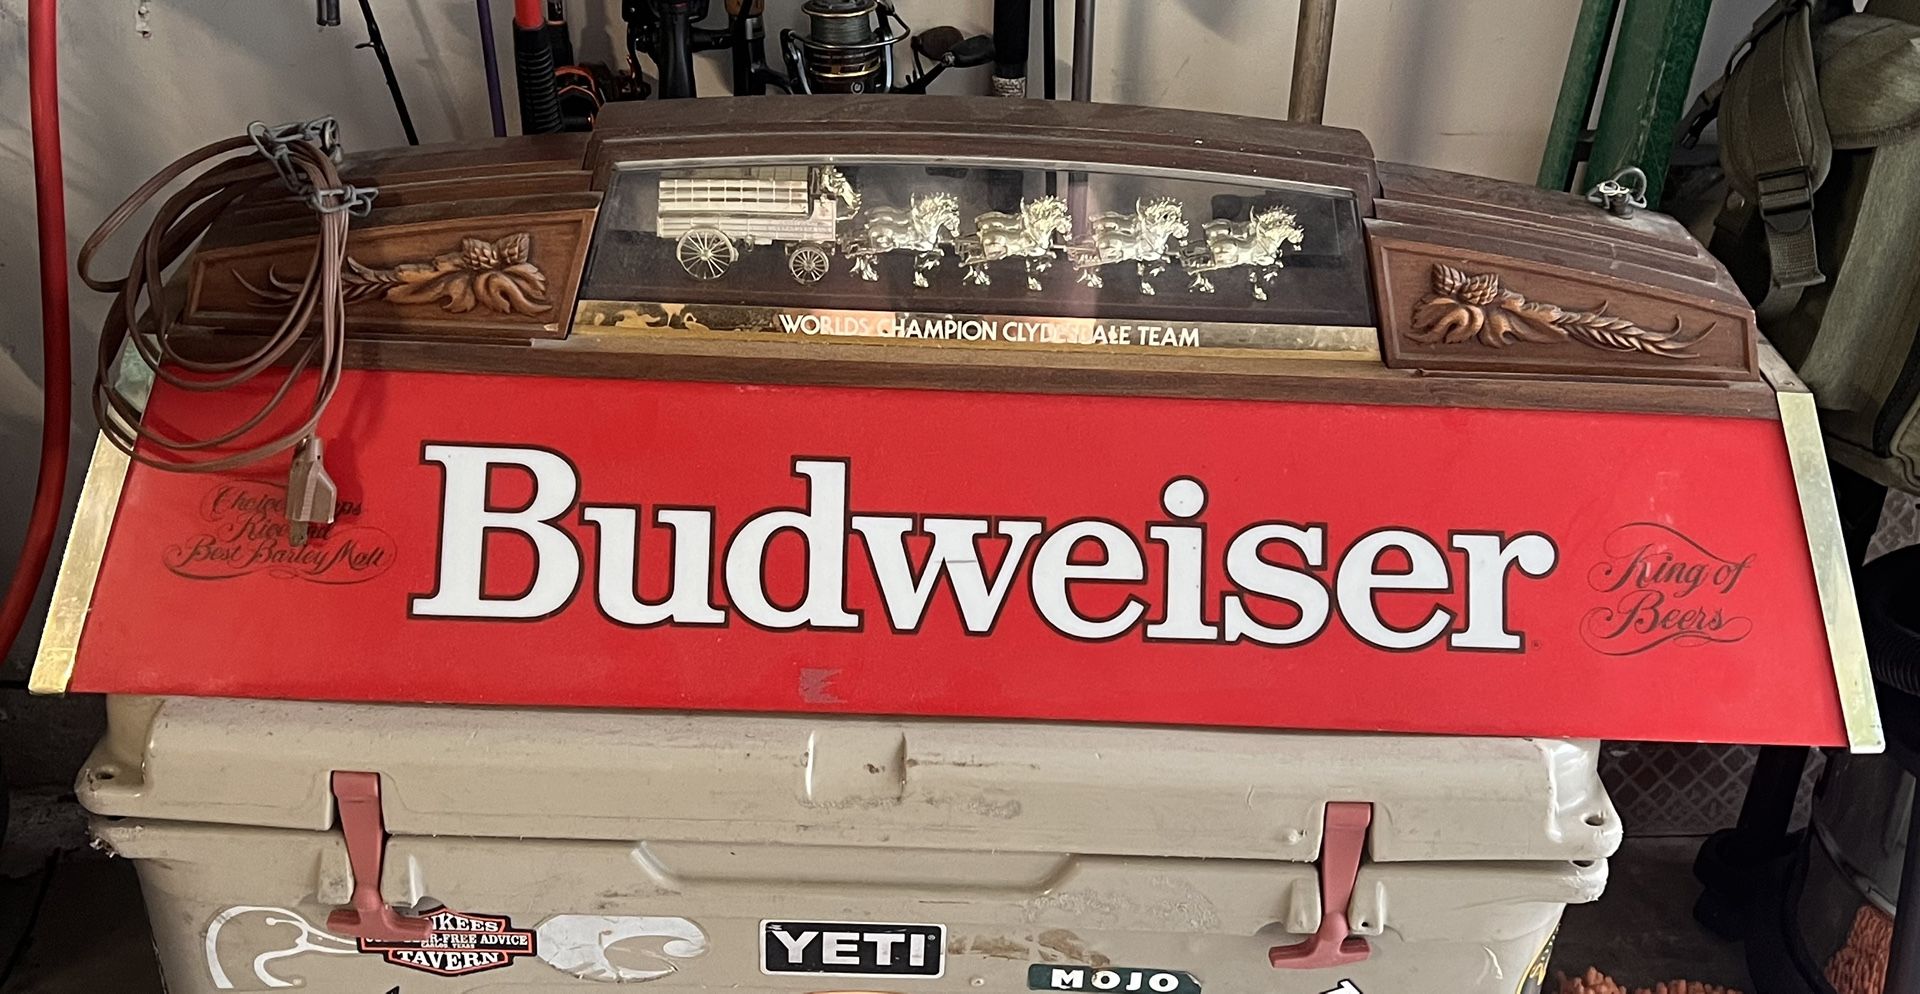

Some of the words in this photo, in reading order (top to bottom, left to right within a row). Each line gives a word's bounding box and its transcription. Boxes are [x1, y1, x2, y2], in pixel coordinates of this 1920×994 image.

[779, 314, 869, 336] WORLDS
[876, 316, 998, 341] CHAMPION
[1002, 321, 1131, 345] CLYDESDALE
[1137, 325, 1200, 347] TEAM
[178, 533, 242, 568] Best
[236, 538, 329, 572] Barley
[314, 539, 385, 571] Malt
[407, 440, 1557, 654] Budweiser
[1588, 543, 1708, 597] King
[1713, 553, 1757, 593] of
[1592, 589, 1728, 640] Beers
[481, 934, 528, 946] ADVICE
[771, 930, 926, 967] YETI
[396, 951, 500, 971] TAVERN
[1050, 968, 1180, 993] MOJO
